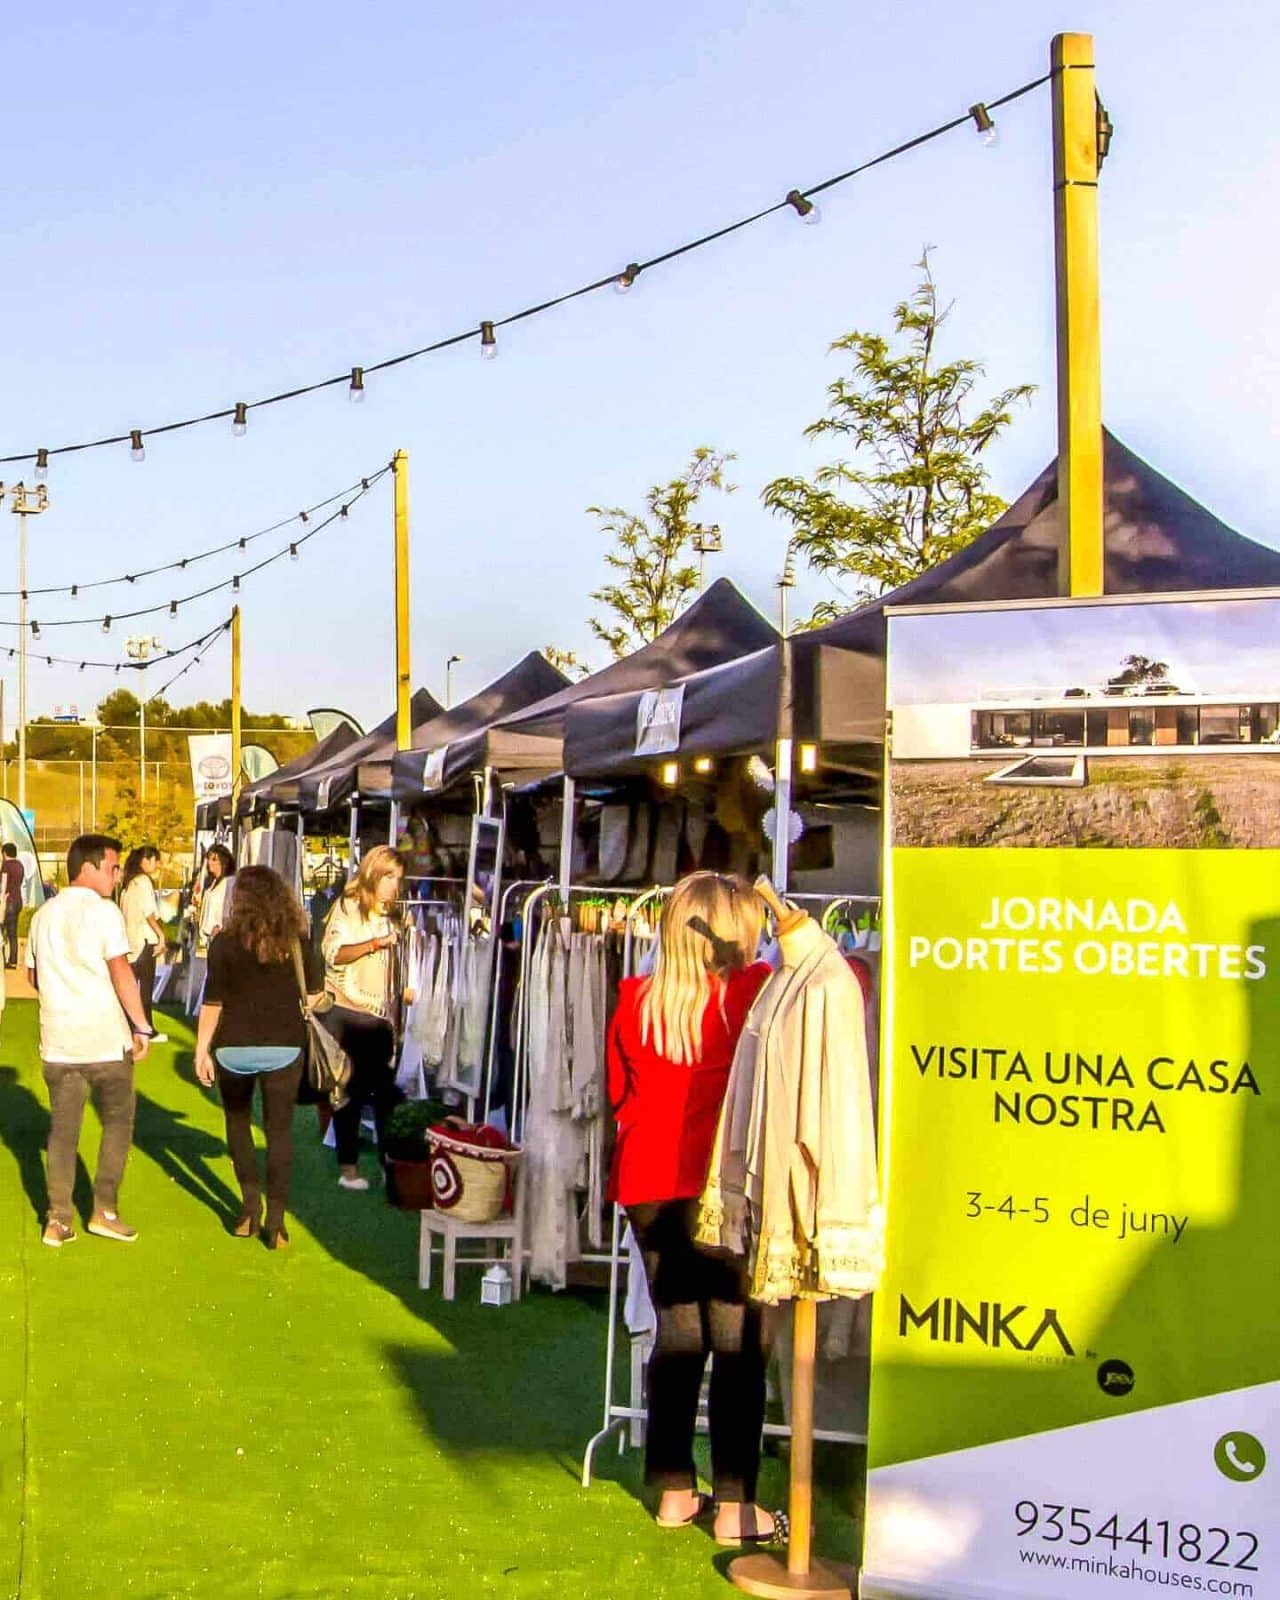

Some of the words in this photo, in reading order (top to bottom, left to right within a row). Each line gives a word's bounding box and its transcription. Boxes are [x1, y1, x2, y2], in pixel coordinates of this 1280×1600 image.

[980, 896, 1187, 935] JORNADA
[909, 936, 1063, 974] PORTES
[1073, 941, 1267, 980] OBERTES
[910, 1045, 1033, 1083] VISITA
[1045, 1052, 1135, 1089] UNA
[1146, 1058, 1262, 1096] CASA
[993, 1092, 1166, 1134] NOSTRA
[966, 1192, 1050, 1224] 3-4-5
[1070, 1194, 1110, 1228] de
[1117, 1203, 1189, 1244] juny
[899, 1293, 1075, 1356] MINKA
[1015, 1500, 1260, 1572] 935441822
[1019, 1549, 1253, 1598] www.minkahouses.com
